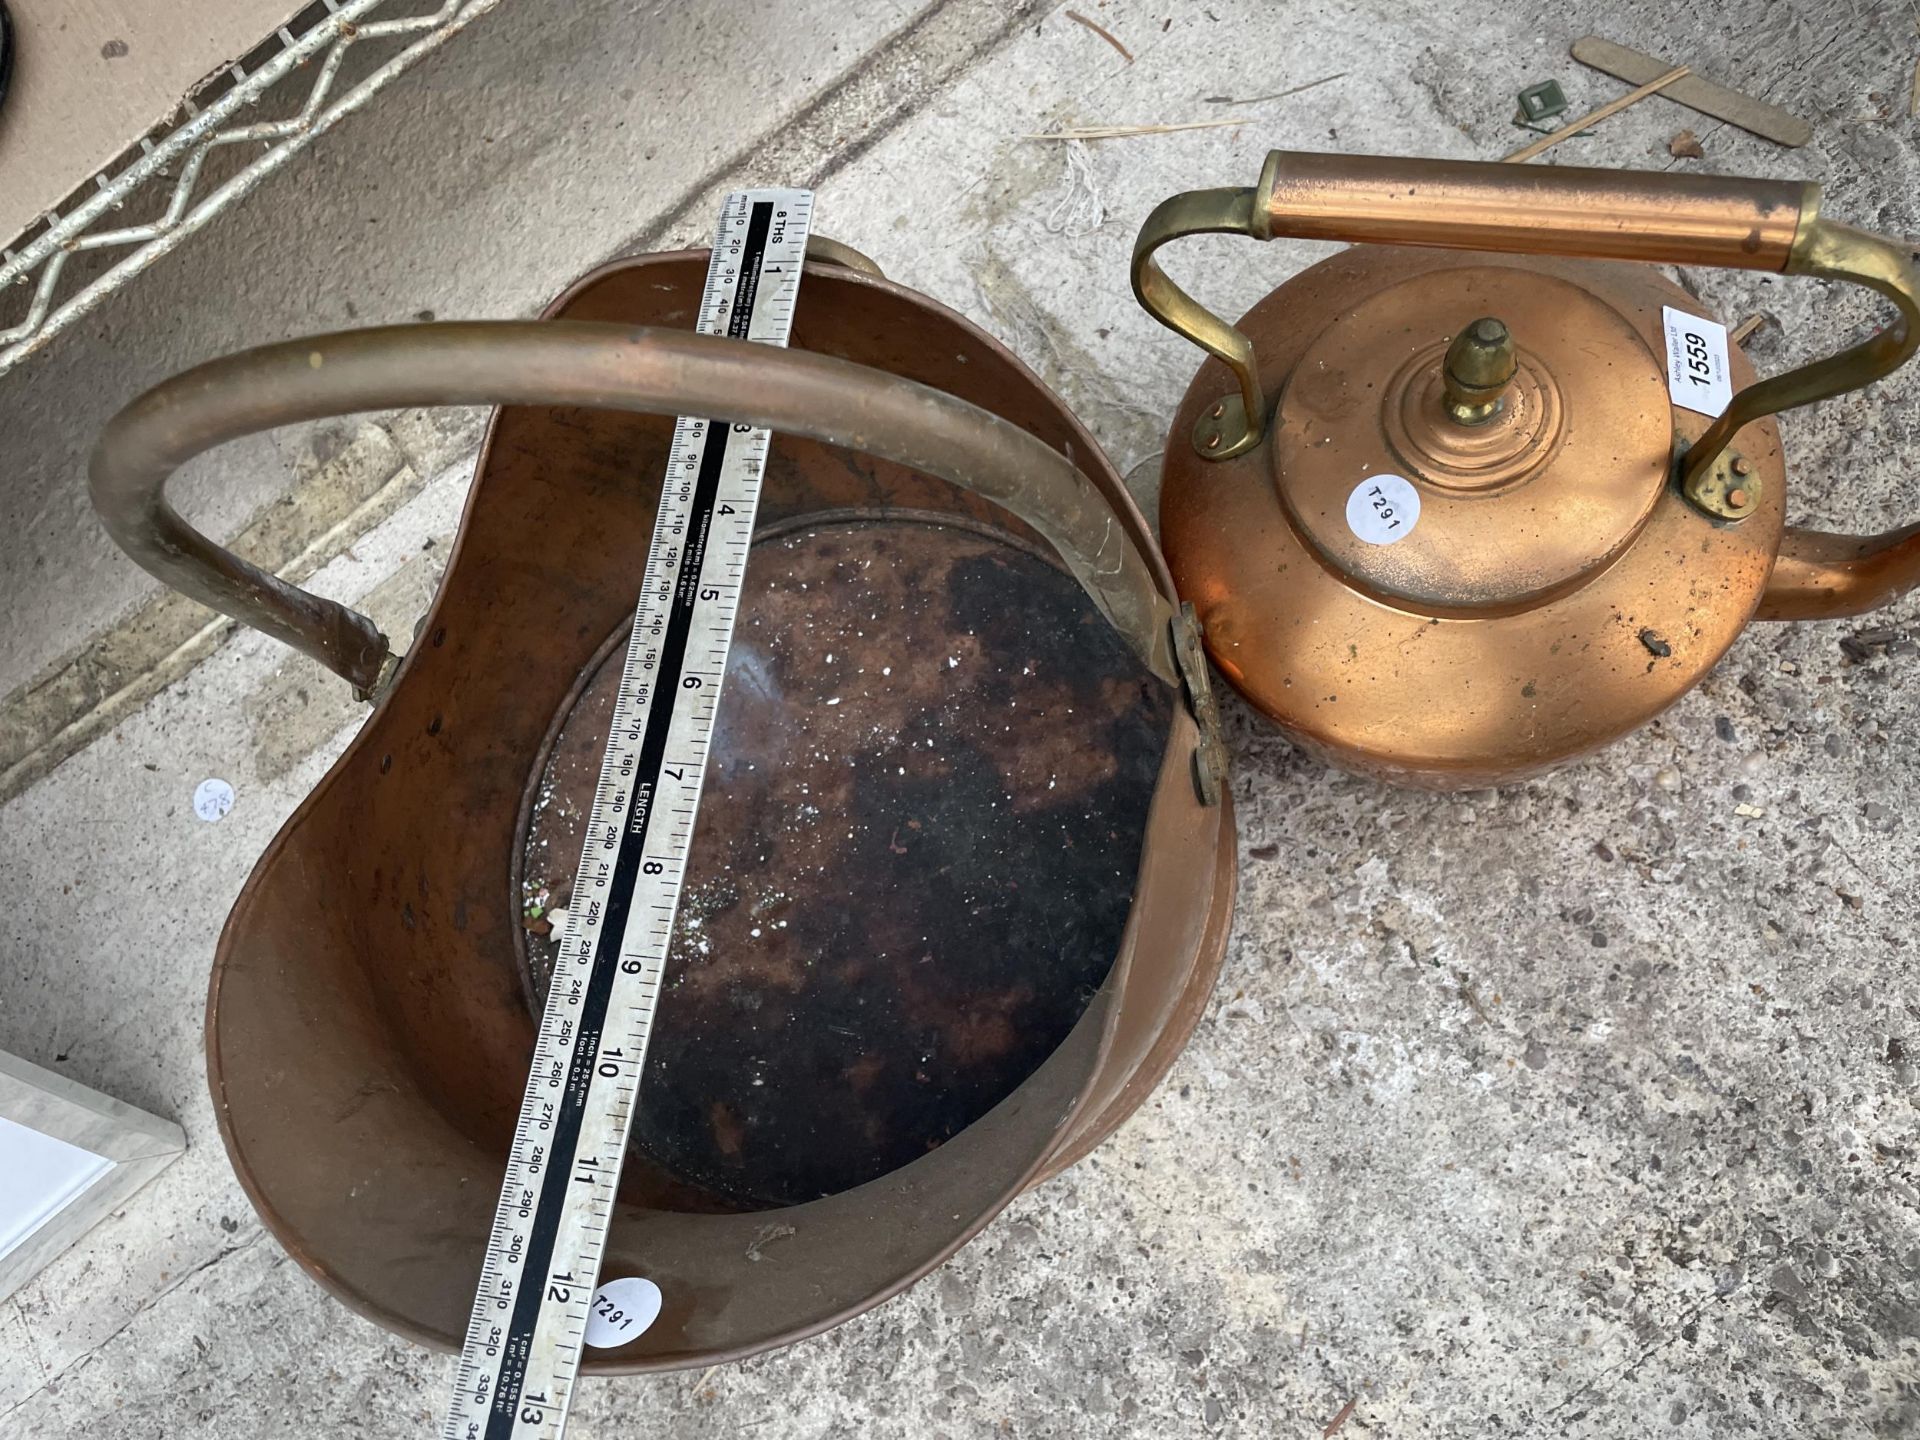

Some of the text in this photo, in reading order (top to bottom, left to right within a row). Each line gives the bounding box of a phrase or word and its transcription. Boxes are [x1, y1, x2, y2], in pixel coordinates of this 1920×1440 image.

[729, 239, 740, 254] 20
[723, 268, 734, 283] 30
[717, 298, 728, 313] 40
[1684, 332, 1711, 386] 1559
[1674, 360, 1682, 383] Ashley
[691, 422, 703, 437] 80
[733, 423, 751, 432] 3
[685, 454, 696, 470] 90
[678, 481, 690, 501] 100
[716, 504, 735, 515] 4
[1368, 486, 1400, 529] T291
[672, 513, 684, 534] 110
[665, 546, 677, 567] 120
[684, 549, 692, 565] mile
[658, 580, 670, 601] 130
[699, 588, 719, 600] 5
[650, 613, 663, 635] 140
[643, 648, 656, 669] 150
[636, 682, 648, 704] 160
[682, 676, 701, 689] 6
[628, 717, 641, 740] 170
[620, 753, 633, 776] 180
[664, 768, 683, 780] 7
[612, 790, 625, 812] 190
[631, 782, 651, 833] LENGTH
[603, 825, 617, 849] 200
[595, 863, 609, 887] 210
[642, 861, 663, 874] 8
[586, 901, 600, 925] 220
[577, 940, 591, 964] 230
[620, 960, 641, 974] 9
[567, 979, 582, 1005] 240
[558, 1020, 572, 1045] 250
[577, 1037, 587, 1055] foot
[587, 1037, 597, 1056] inch
[597, 1047, 622, 1077] 10
[548, 1061, 563, 1087] 260
[571, 1067, 580, 1081] 0.3
[580, 1068, 590, 1087] 25.4
[575, 1090, 584, 1106] mm
[538, 1103, 553, 1130] 270
[528, 1146, 543, 1173] 280
[574, 1156, 598, 1184] 11
[518, 1190, 533, 1218] 290
[507, 1234, 522, 1263] 300
[496, 1280, 512, 1309] 310
[547, 1271, 573, 1303] 12
[592, 1295, 633, 1330] T291
[485, 1326, 501, 1356] 320
[474, 1374, 490, 1404] 330
[498, 1370, 510, 1398] 10.76
[508, 1371, 521, 1400] 0.155
[520, 1392, 546, 1425] 13
[465, 1422, 478, 1440] 34
